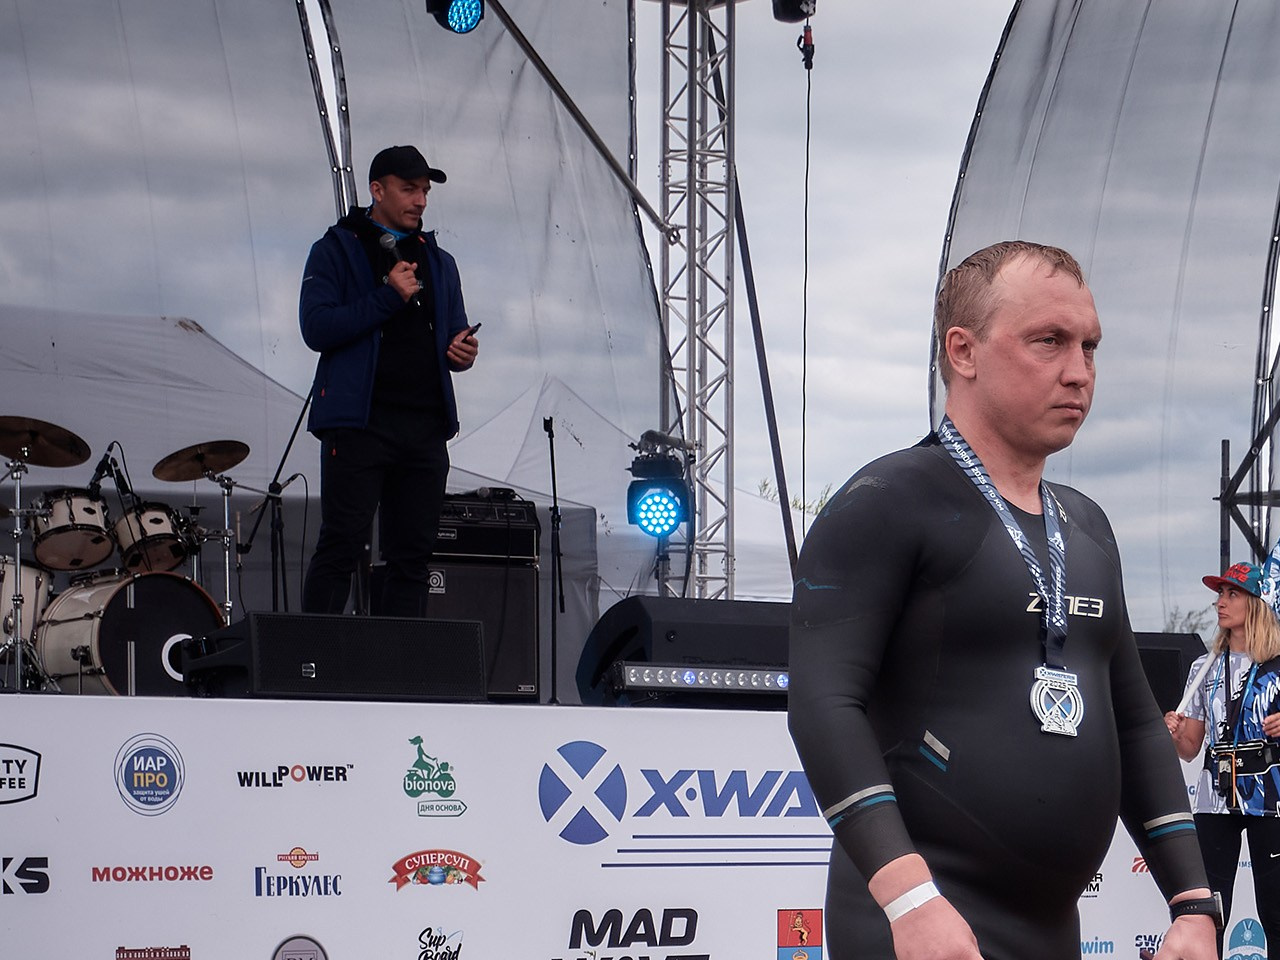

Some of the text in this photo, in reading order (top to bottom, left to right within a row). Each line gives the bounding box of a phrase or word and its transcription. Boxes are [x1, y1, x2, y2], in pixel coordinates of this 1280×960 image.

[952, 441, 975, 467] MUROM
[971, 467, 987, 485] 2025
[993, 498, 1004, 511] KM
[1026, 592, 1104, 618] ZNE3
[133, 756, 167, 771] ИАР
[133, 773, 168, 788] ПРО
[405, 777, 455, 791] bionova
[420, 804, 463, 812] ДНЯ ОСНОВА
[405, 853, 469, 870] СУПЕРСУП
[569, 908, 698, 949] MAD
